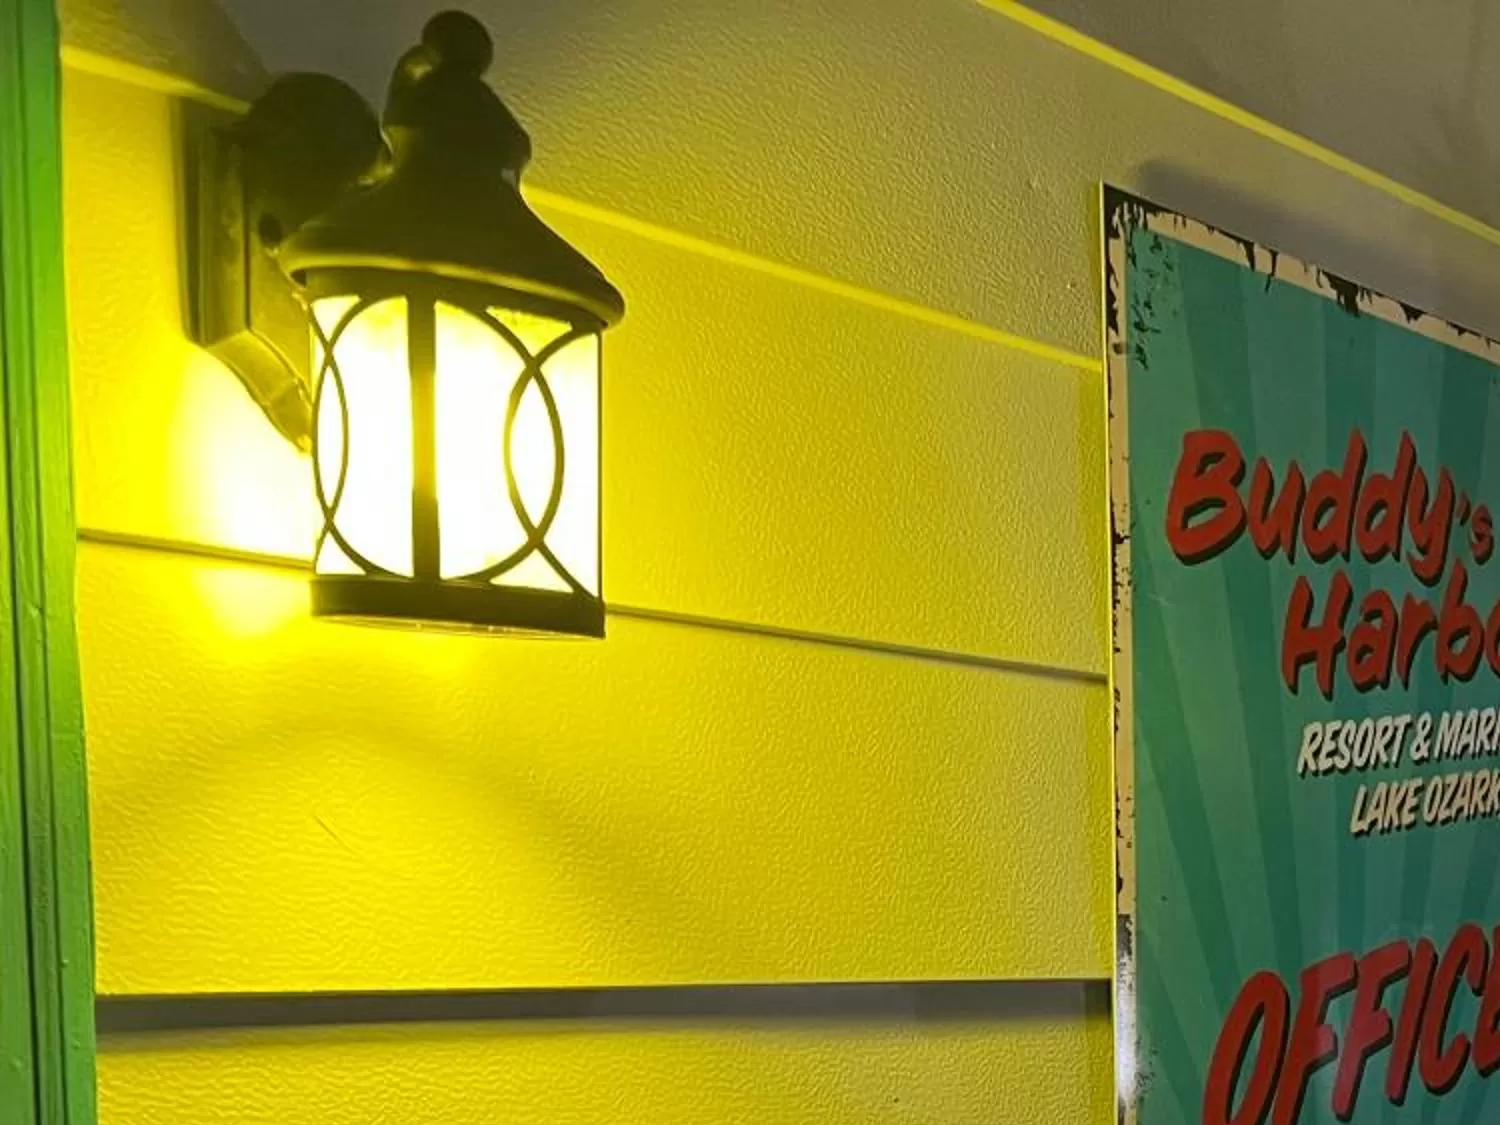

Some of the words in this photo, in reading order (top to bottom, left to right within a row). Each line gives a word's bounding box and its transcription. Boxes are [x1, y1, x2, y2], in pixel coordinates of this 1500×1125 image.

[1166, 425, 1495, 584] Buddy's
[1297, 712, 1411, 777] RESORT
[1409, 714, 1431, 764] &
[1350, 776, 1425, 837] LAKE
